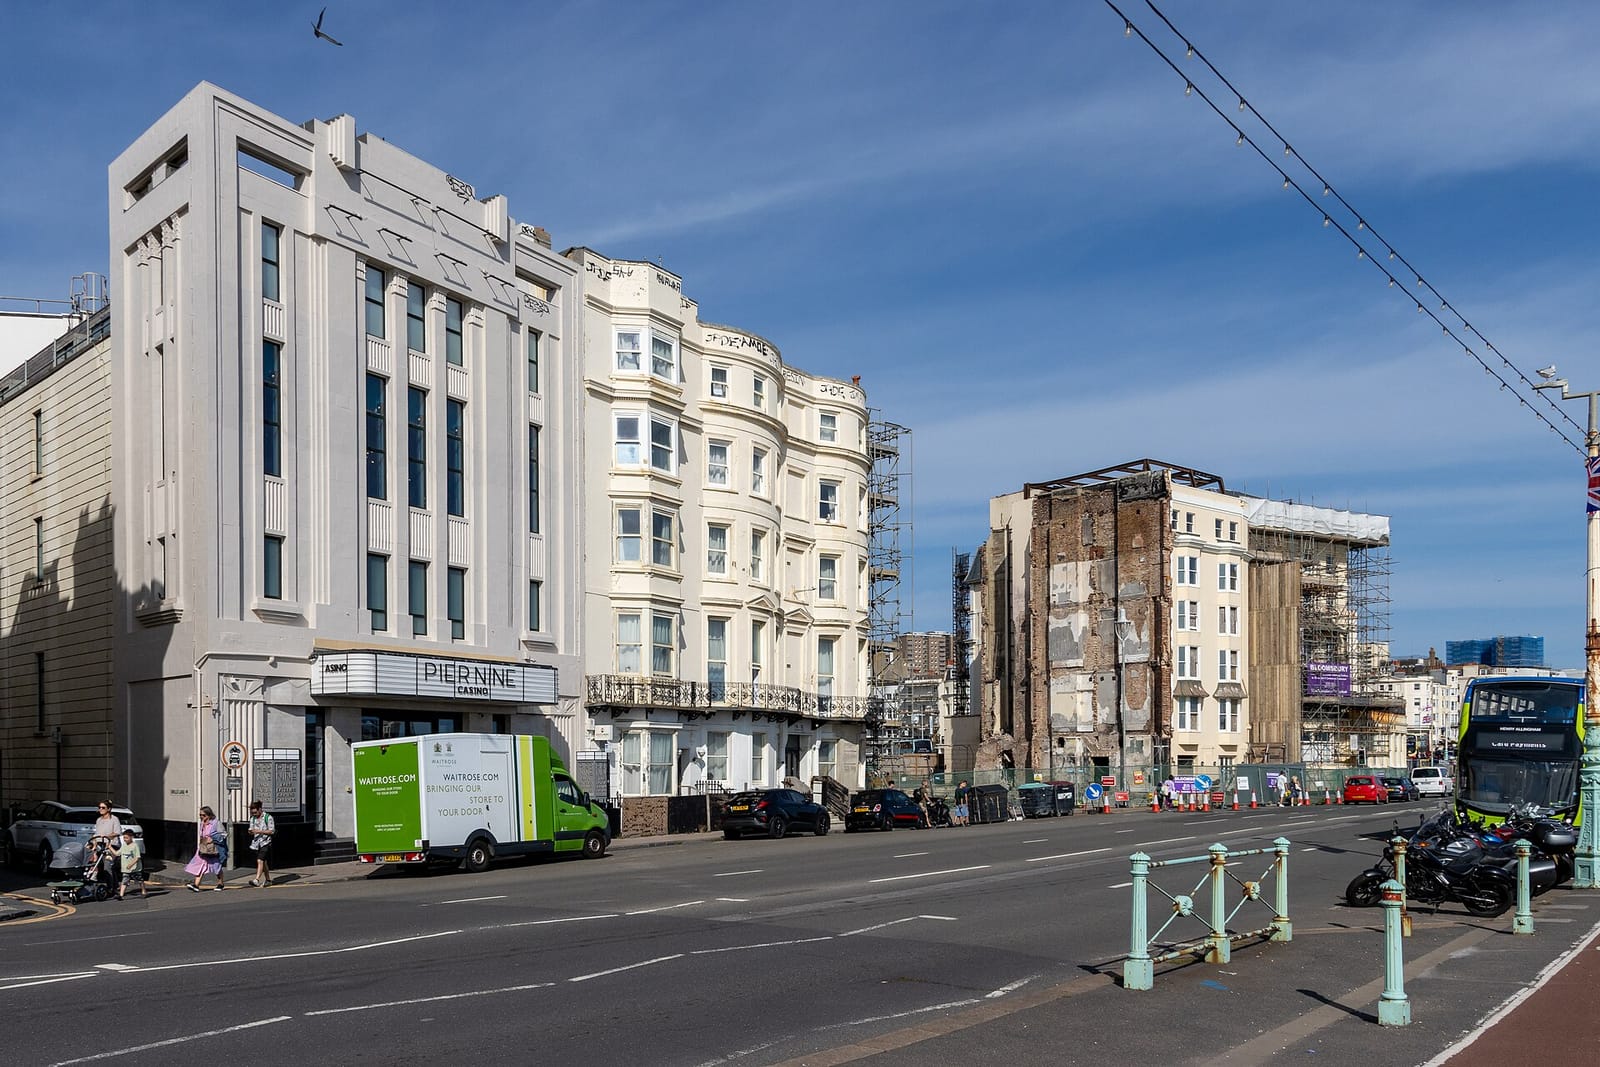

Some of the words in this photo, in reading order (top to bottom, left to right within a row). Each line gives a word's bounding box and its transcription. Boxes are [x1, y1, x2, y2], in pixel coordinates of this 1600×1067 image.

[424, 662, 470, 684] PIER
[474, 666, 516, 688] NINE
[457, 685, 489, 696] CASINO
[358, 774, 416, 785] WAITROSE.COM
[442, 773, 499, 781] WAITROSE.COM
[426, 784, 464, 793] BRINGING
[465, 784, 482, 793] OUR
[469, 796, 492, 804] STORE
[494, 795, 504, 803] TO
[438, 809, 459, 817] YOUR
[461, 808, 483, 816] DOOR
